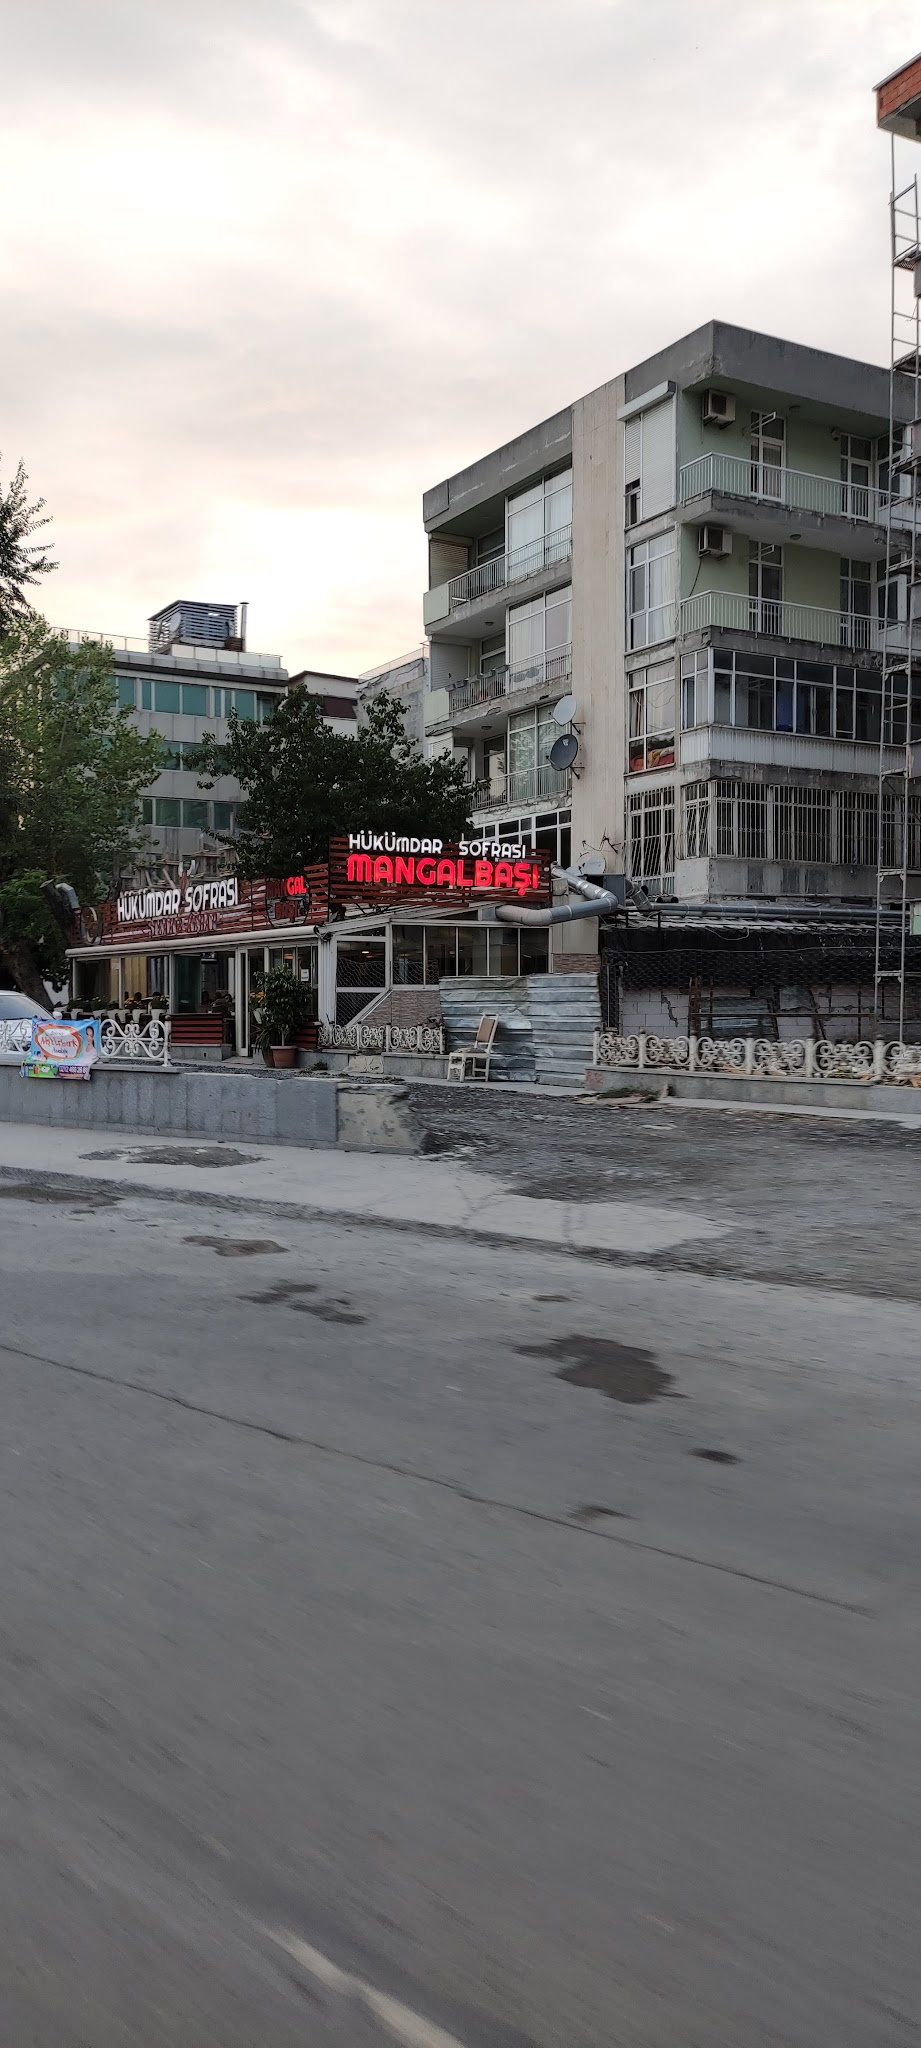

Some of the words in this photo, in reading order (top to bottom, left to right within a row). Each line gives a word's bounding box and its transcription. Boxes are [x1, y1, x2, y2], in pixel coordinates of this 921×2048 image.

[348, 830, 443, 854] HÜKÜMDAR
[458, 840, 526, 859] SOFRASI
[347, 853, 539, 896] MANGALBAŞI
[117, 888, 181, 921] HÜKÜMDAR
[184, 877, 239, 913] SOFRASI
